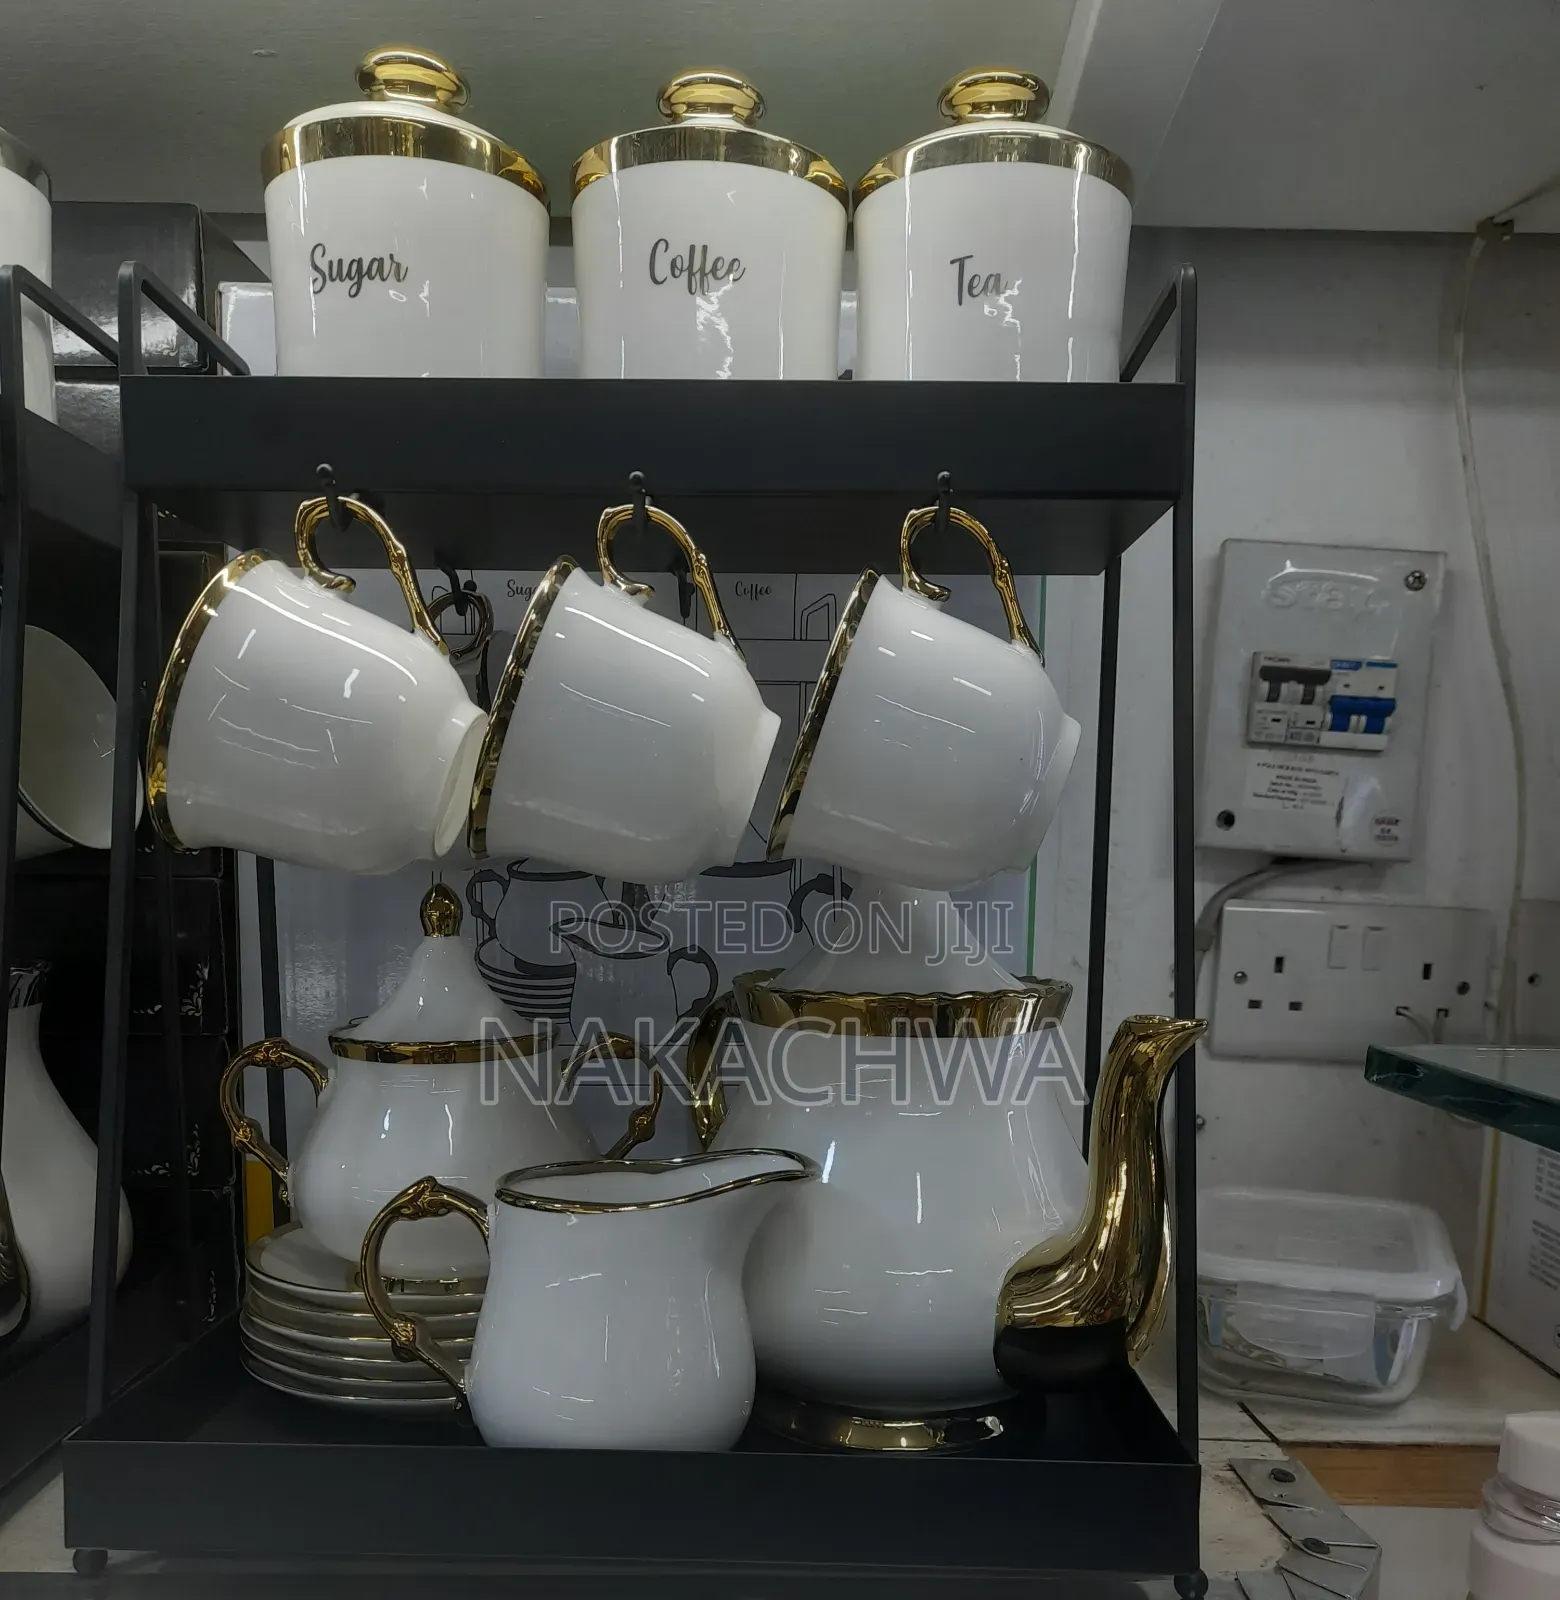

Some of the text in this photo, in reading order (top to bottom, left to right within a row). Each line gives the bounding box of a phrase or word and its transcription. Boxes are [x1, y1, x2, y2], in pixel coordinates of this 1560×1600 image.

[309, 243, 408, 298] Sugar
[649, 238, 746, 295] Coffee
[950, 254, 1008, 306] Tea
[507, 579, 538, 601] Sug
[735, 580, 772, 601] Coffee
